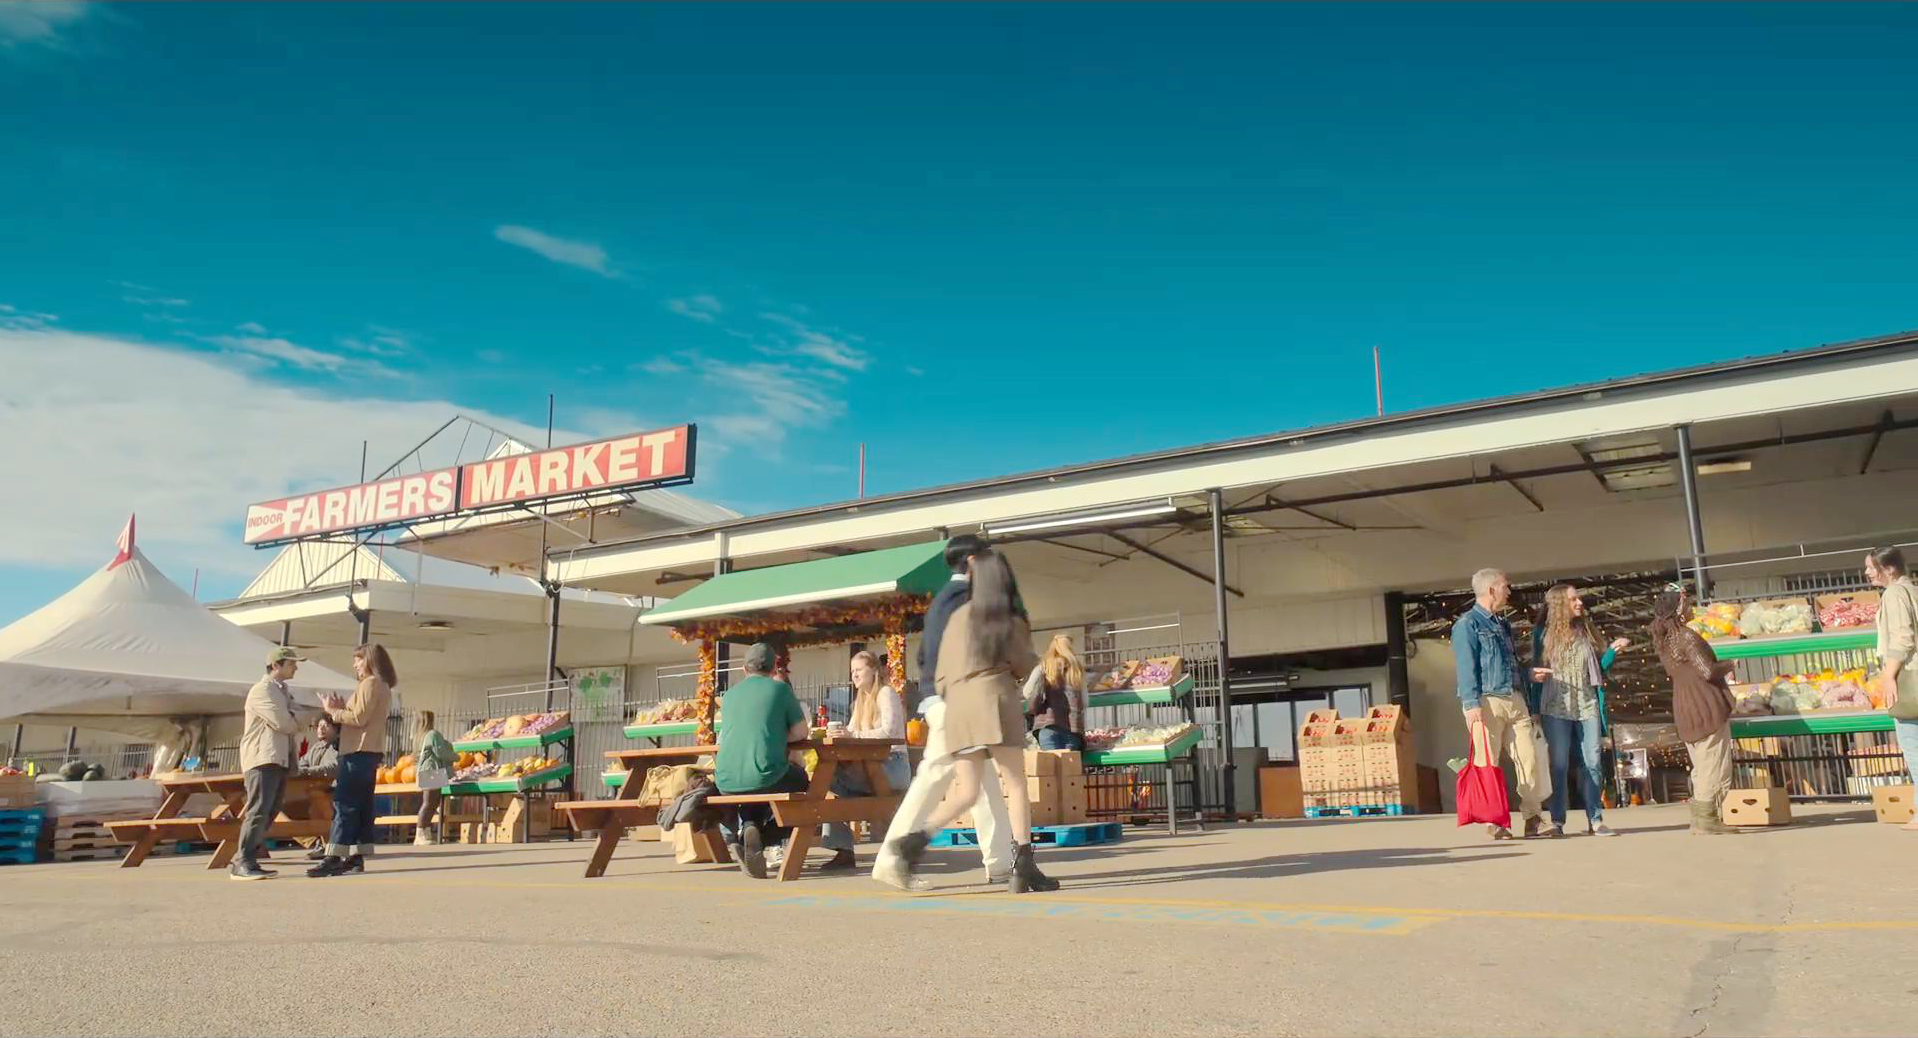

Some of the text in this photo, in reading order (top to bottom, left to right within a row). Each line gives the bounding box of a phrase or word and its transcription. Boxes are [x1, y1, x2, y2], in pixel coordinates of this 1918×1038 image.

[248, 430, 676, 535] INDOOR FARMERS MARKET
